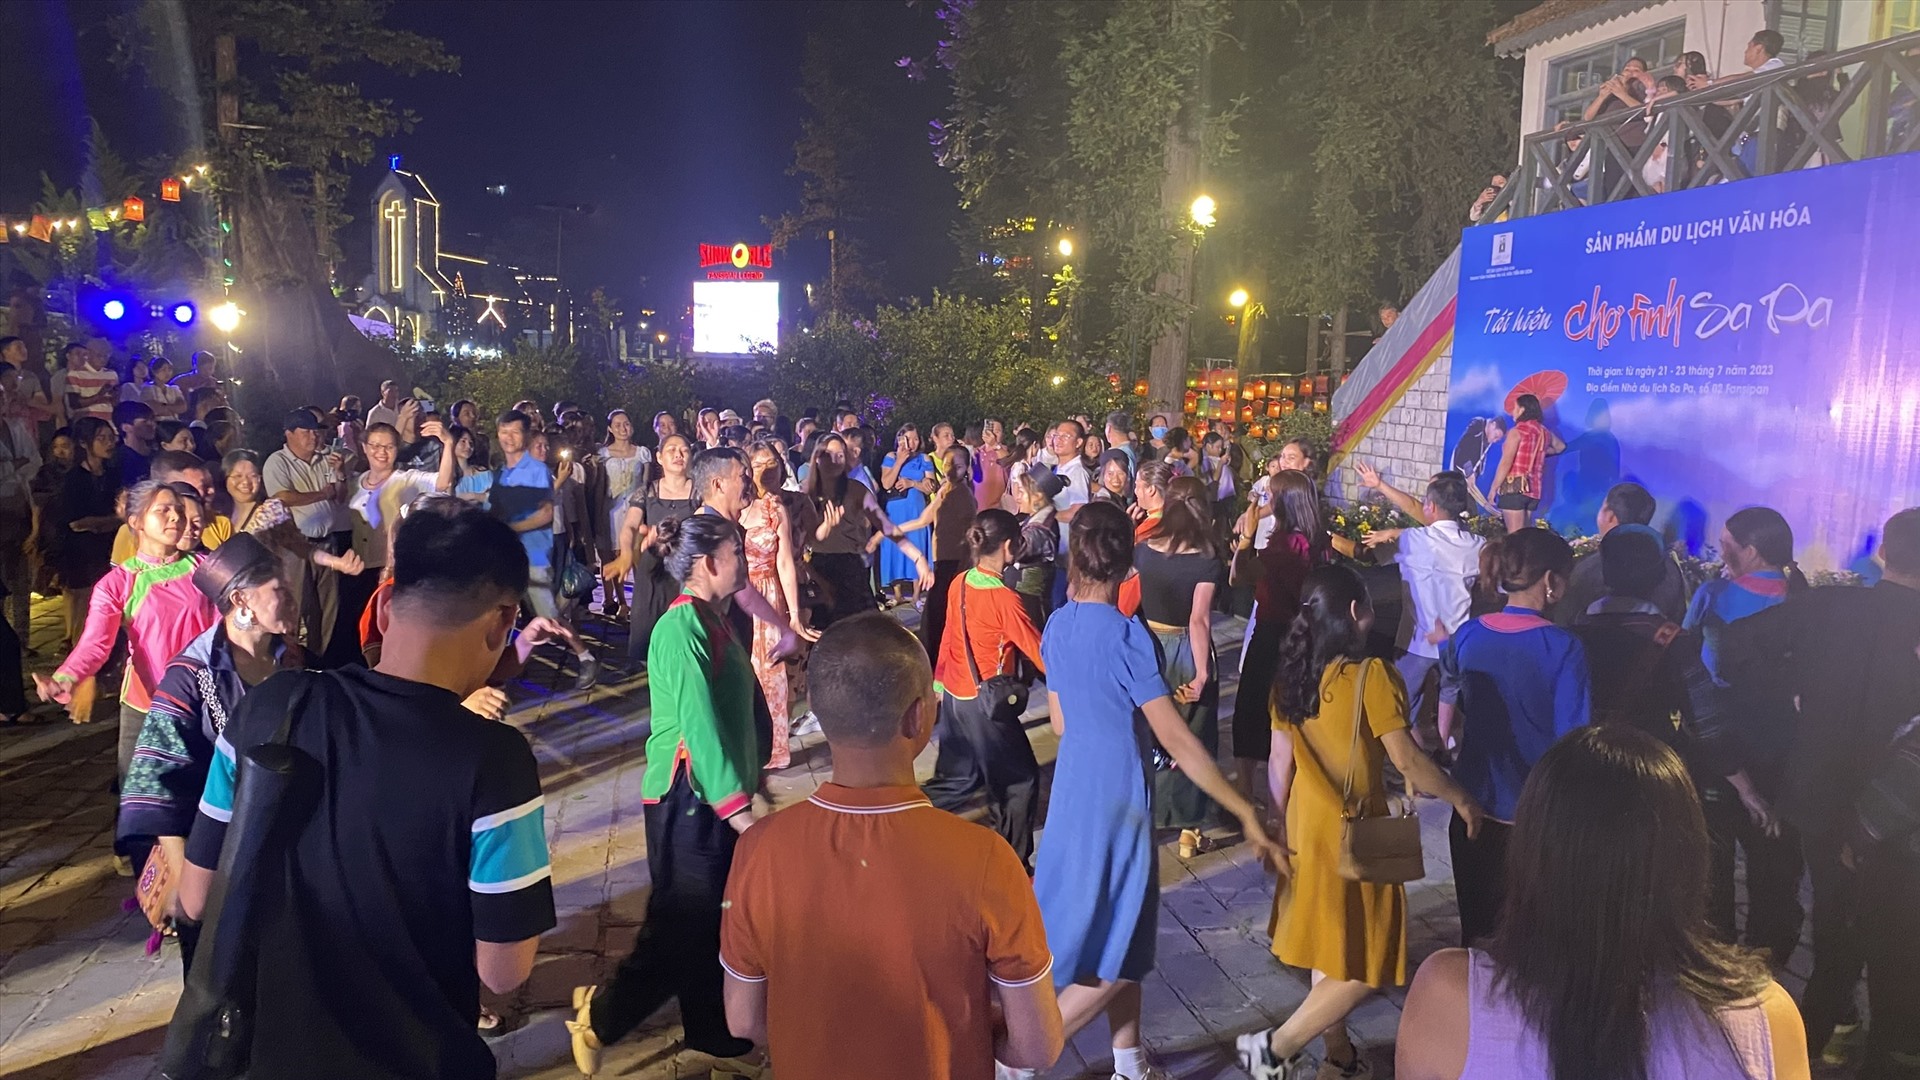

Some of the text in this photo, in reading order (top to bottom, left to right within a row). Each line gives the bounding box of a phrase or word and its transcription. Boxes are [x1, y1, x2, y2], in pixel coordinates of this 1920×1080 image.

[1585, 202, 1811, 254] SẢN PHẨM DU LỊCH VĂN HÓA
[1483, 307, 1514, 334] Tái
[1511, 306, 1553, 337] hiện
[1689, 291, 1752, 339] Sa
[1759, 282, 1833, 334] Pa
[1604, 366, 1624, 379] gian:
[1635, 365, 1656, 379] ngày
[1657, 365, 1668, 376] 21
[1675, 365, 1686, 376] 23
[1688, 364, 1715, 379] tháng
[1717, 365, 1723, 376] 7
[1725, 364, 1747, 376] năm
[1749, 364, 1774, 376] 2023
[1639, 382, 1650, 392] du
[1652, 382, 1668, 395] lịch
[1669, 382, 1681, 393] Sa
[1698, 380, 1711, 394] số
